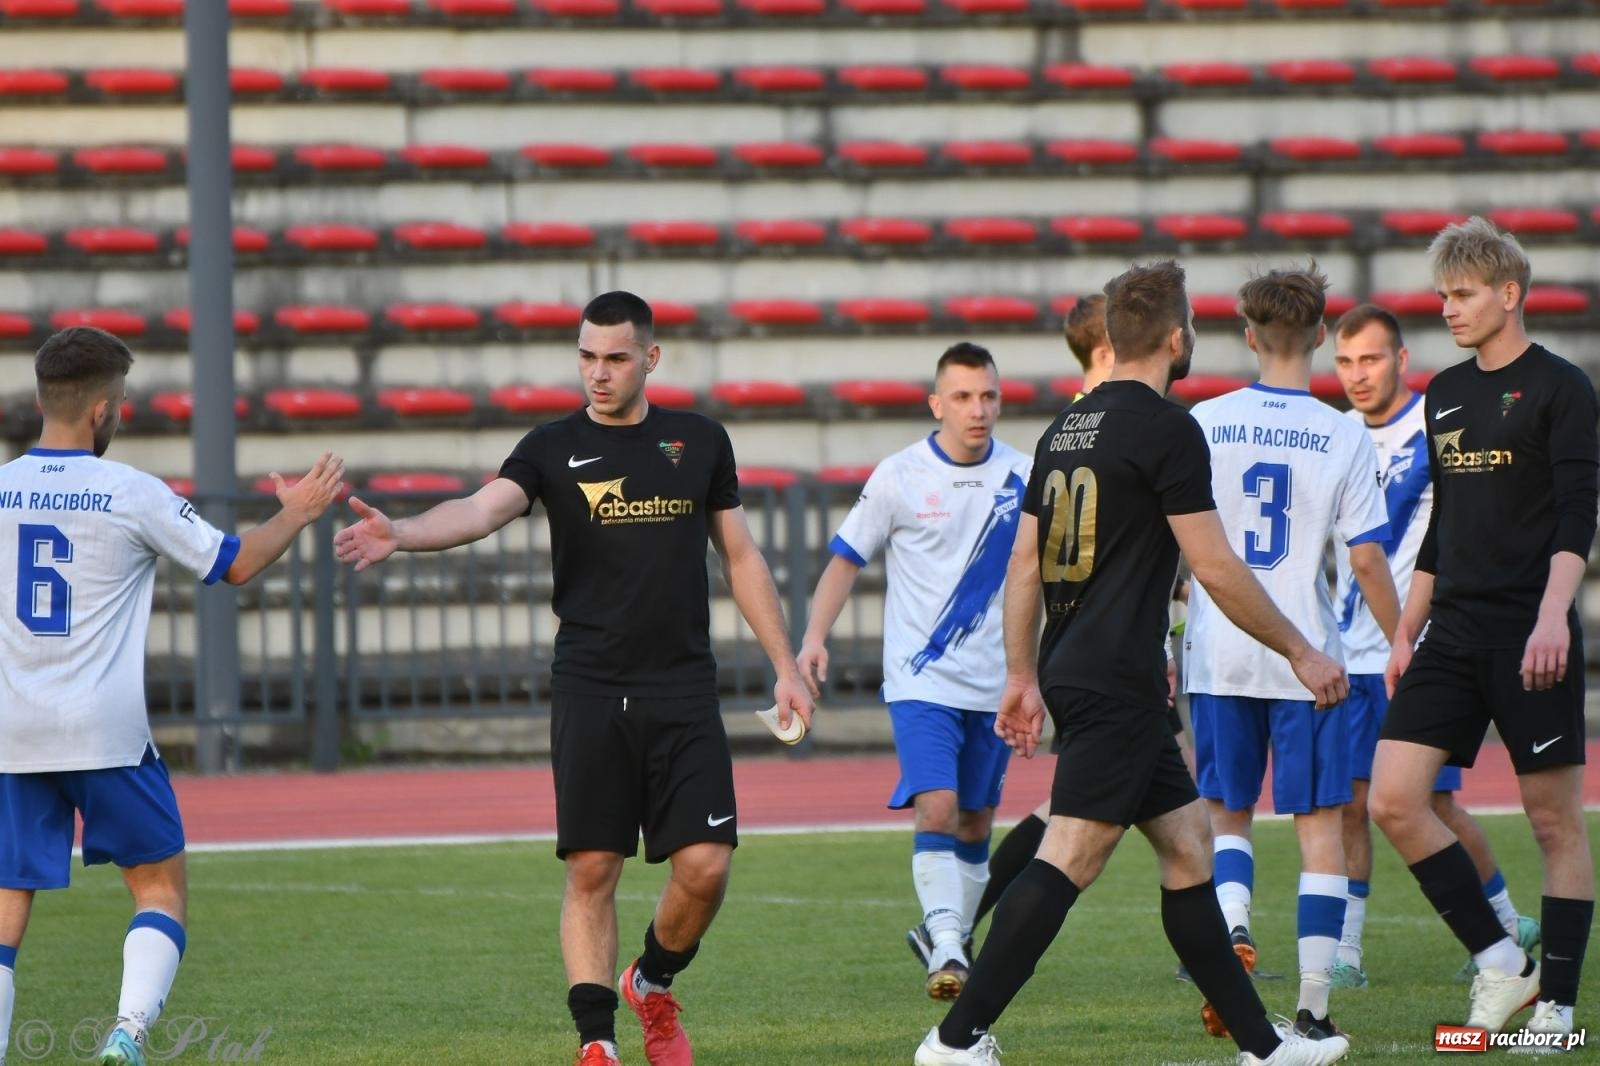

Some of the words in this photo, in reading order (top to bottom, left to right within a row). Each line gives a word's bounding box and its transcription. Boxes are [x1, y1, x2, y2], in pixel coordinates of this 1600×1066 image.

[1261, 400, 1287, 410] 1946
[1061, 411, 1106, 432] CZARNI
[1050, 430, 1100, 452] GORZYCE
[1212, 424, 1247, 445] UNIA
[1252, 426, 1331, 454] RACIBÓRZ
[40, 463, 65, 474] 1946
[0, 491, 23, 509] NIA
[28, 488, 113, 513] RACIBÓRZ
[598, 496, 693, 518] abastran
[1041, 465, 1099, 584] 20
[1242, 461, 1293, 571] 3
[15, 523, 74, 638] 6
